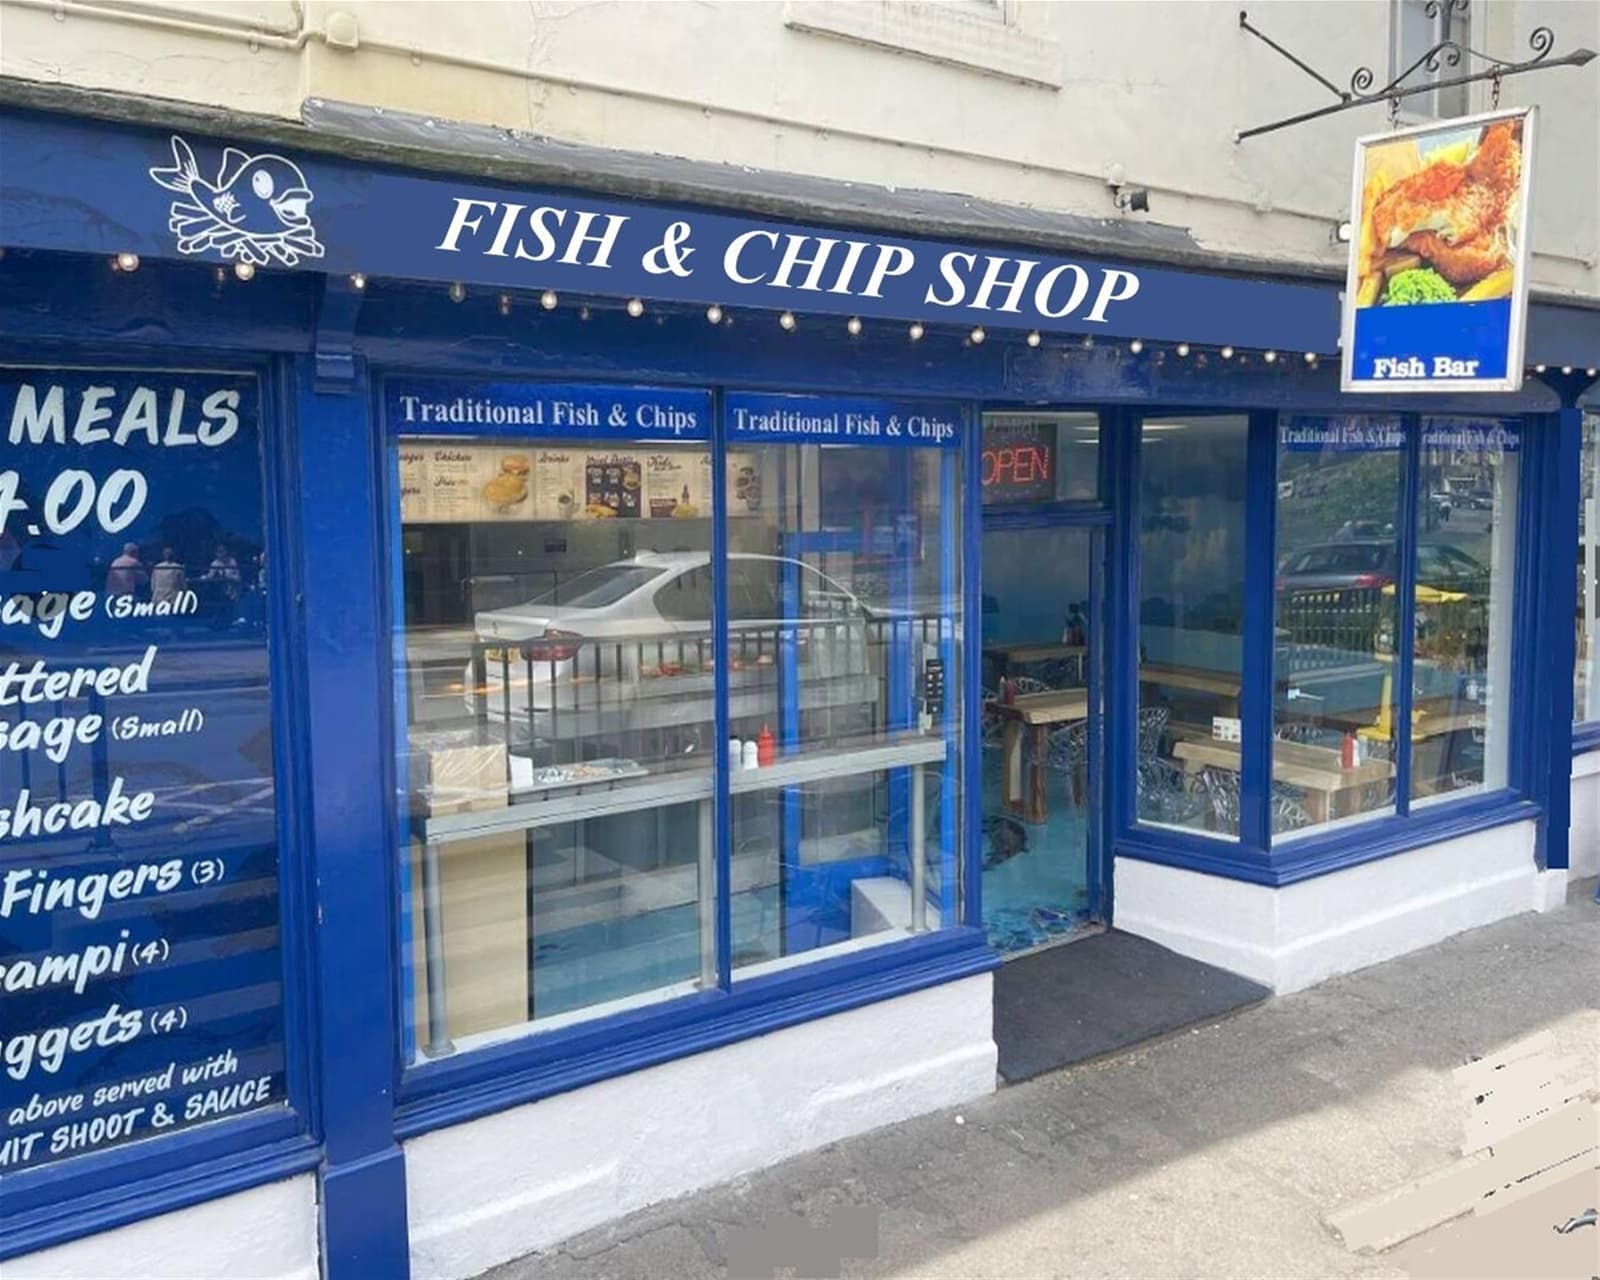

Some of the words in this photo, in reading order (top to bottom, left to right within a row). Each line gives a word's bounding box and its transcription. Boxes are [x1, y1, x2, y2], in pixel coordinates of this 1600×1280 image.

[435, 197, 630, 270] FISH
[641, 220, 697, 277] &
[722, 229, 915, 298] CHIP
[924, 251, 1140, 323] SHOP
[1373, 357, 1426, 378] Fish
[1432, 357, 1480, 377] Bar
[8, 384, 240, 446] MEALS
[400, 397, 544, 425] Traditional
[551, 402, 599, 426] Fish
[608, 403, 628, 427] &
[635, 404, 698, 434] Chips
[734, 408, 839, 434] Traditional
[845, 414, 881, 436] Fish
[886, 416, 902, 437] &
[907, 416, 954, 443] Chips
[1280, 426, 1339, 443] Traditional
[1343, 427, 1363, 443] Fish
[1422, 429, 1461, 445] raditional
[981, 445, 1049, 486] OPEN
[0, 590, 96, 639] age
[105, 589, 198, 619] (Small)
[111, 708, 203, 741] (Small)
[0, 859, 183, 919] Fingers
[191, 857, 225, 885] (3)
[131, 938, 170, 967] (4)
[0, 1003, 143, 1081] ggets
[150, 1006, 188, 1035] (4)
[8, 1093, 84, 1126] above
[92, 1062, 176, 1108] served
[182, 1048, 239, 1085] with
[50, 1107, 146, 1155] SHOOT
[151, 1102, 175, 1128] &
[184, 1075, 272, 1121] SAUCE
